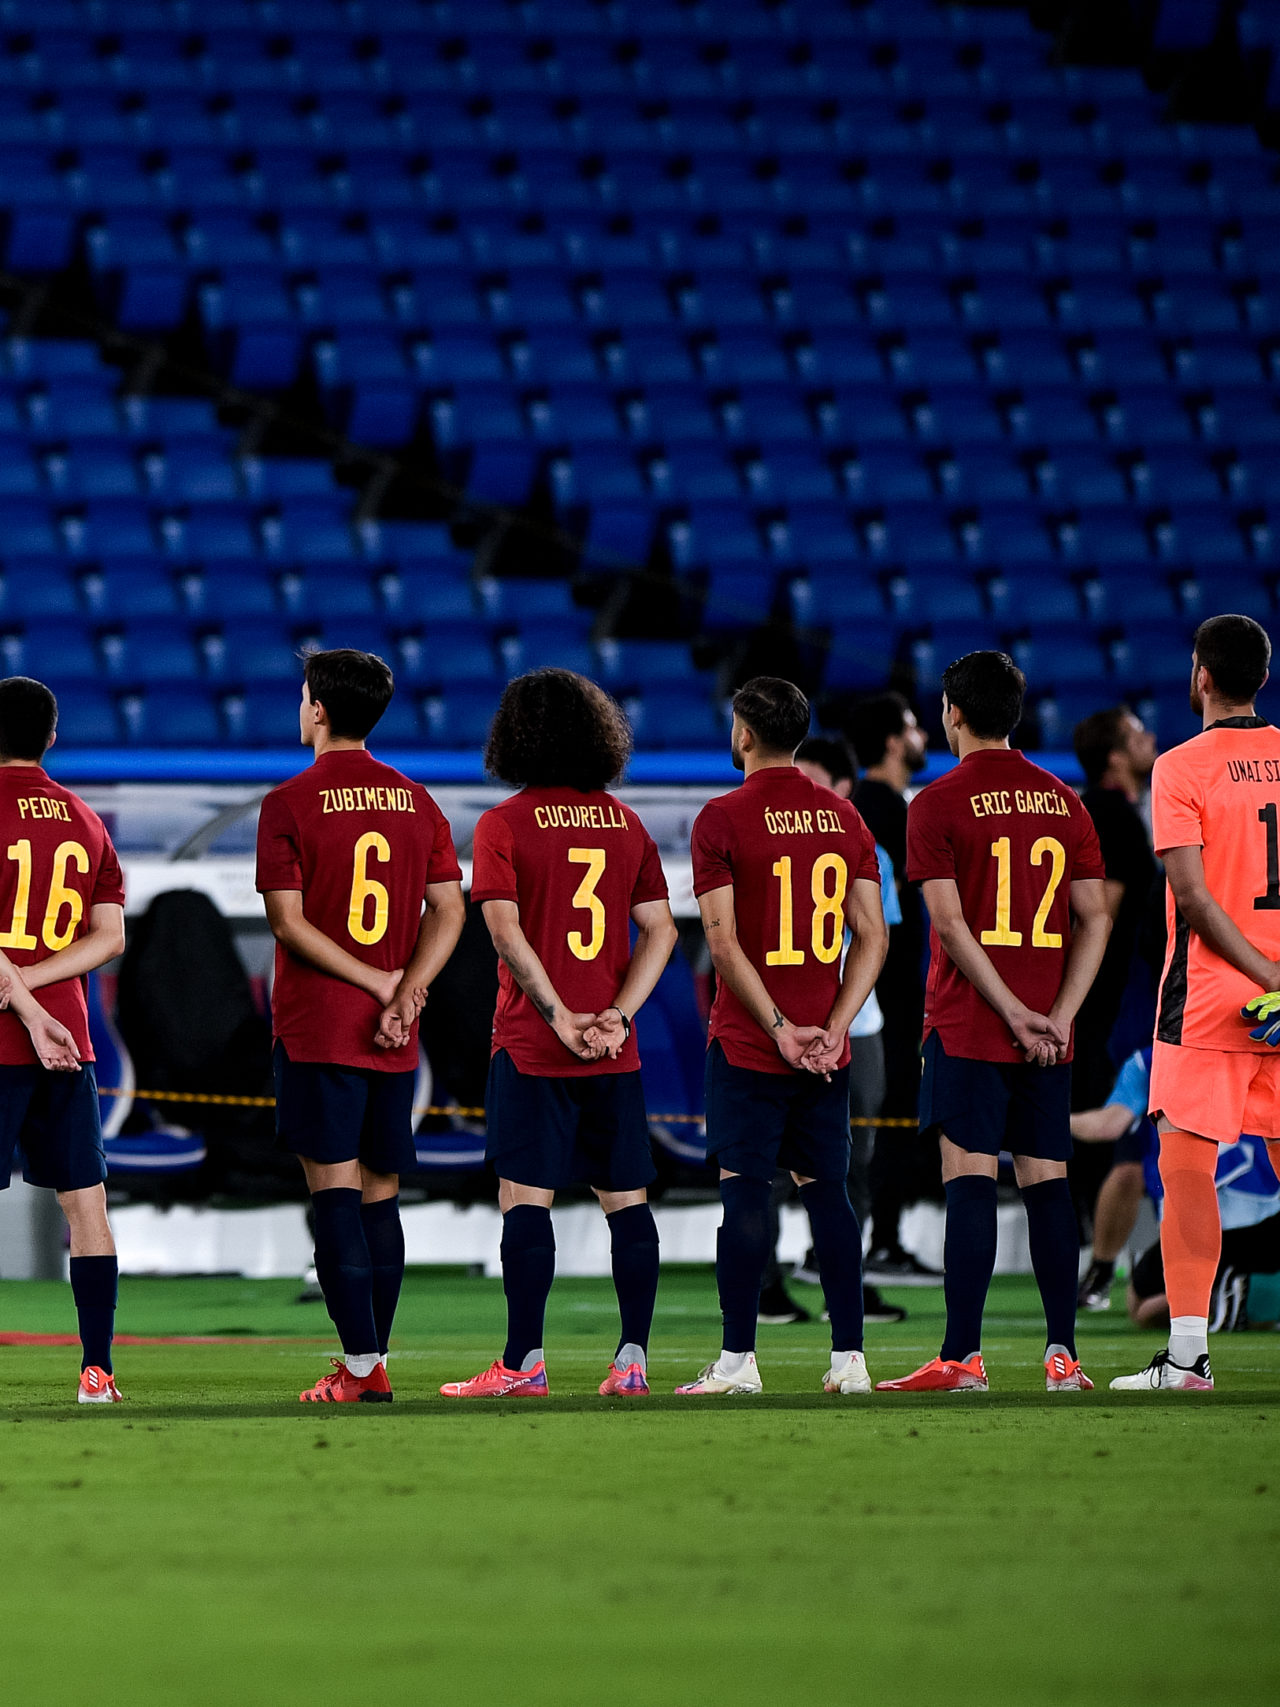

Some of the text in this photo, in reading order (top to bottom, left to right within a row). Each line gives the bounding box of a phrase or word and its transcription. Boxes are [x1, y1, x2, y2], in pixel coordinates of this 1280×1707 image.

[1227, 760, 1280, 783] UNAI SI
[17, 797, 72, 823] PEDRI
[319, 787, 416, 814] ZUBIMENDI
[970, 789, 1071, 818] ERIC GARCÍA
[534, 805, 629, 831] CUCURELLA
[764, 806, 846, 835] ÓSCAR GIL
[1254, 803, 1280, 910] 1
[347, 831, 391, 946] 6
[980, 836, 1067, 949] 12
[566, 847, 606, 961] 3
[765, 852, 848, 967] 18
[493, 1378, 531, 1397] ULTRA
